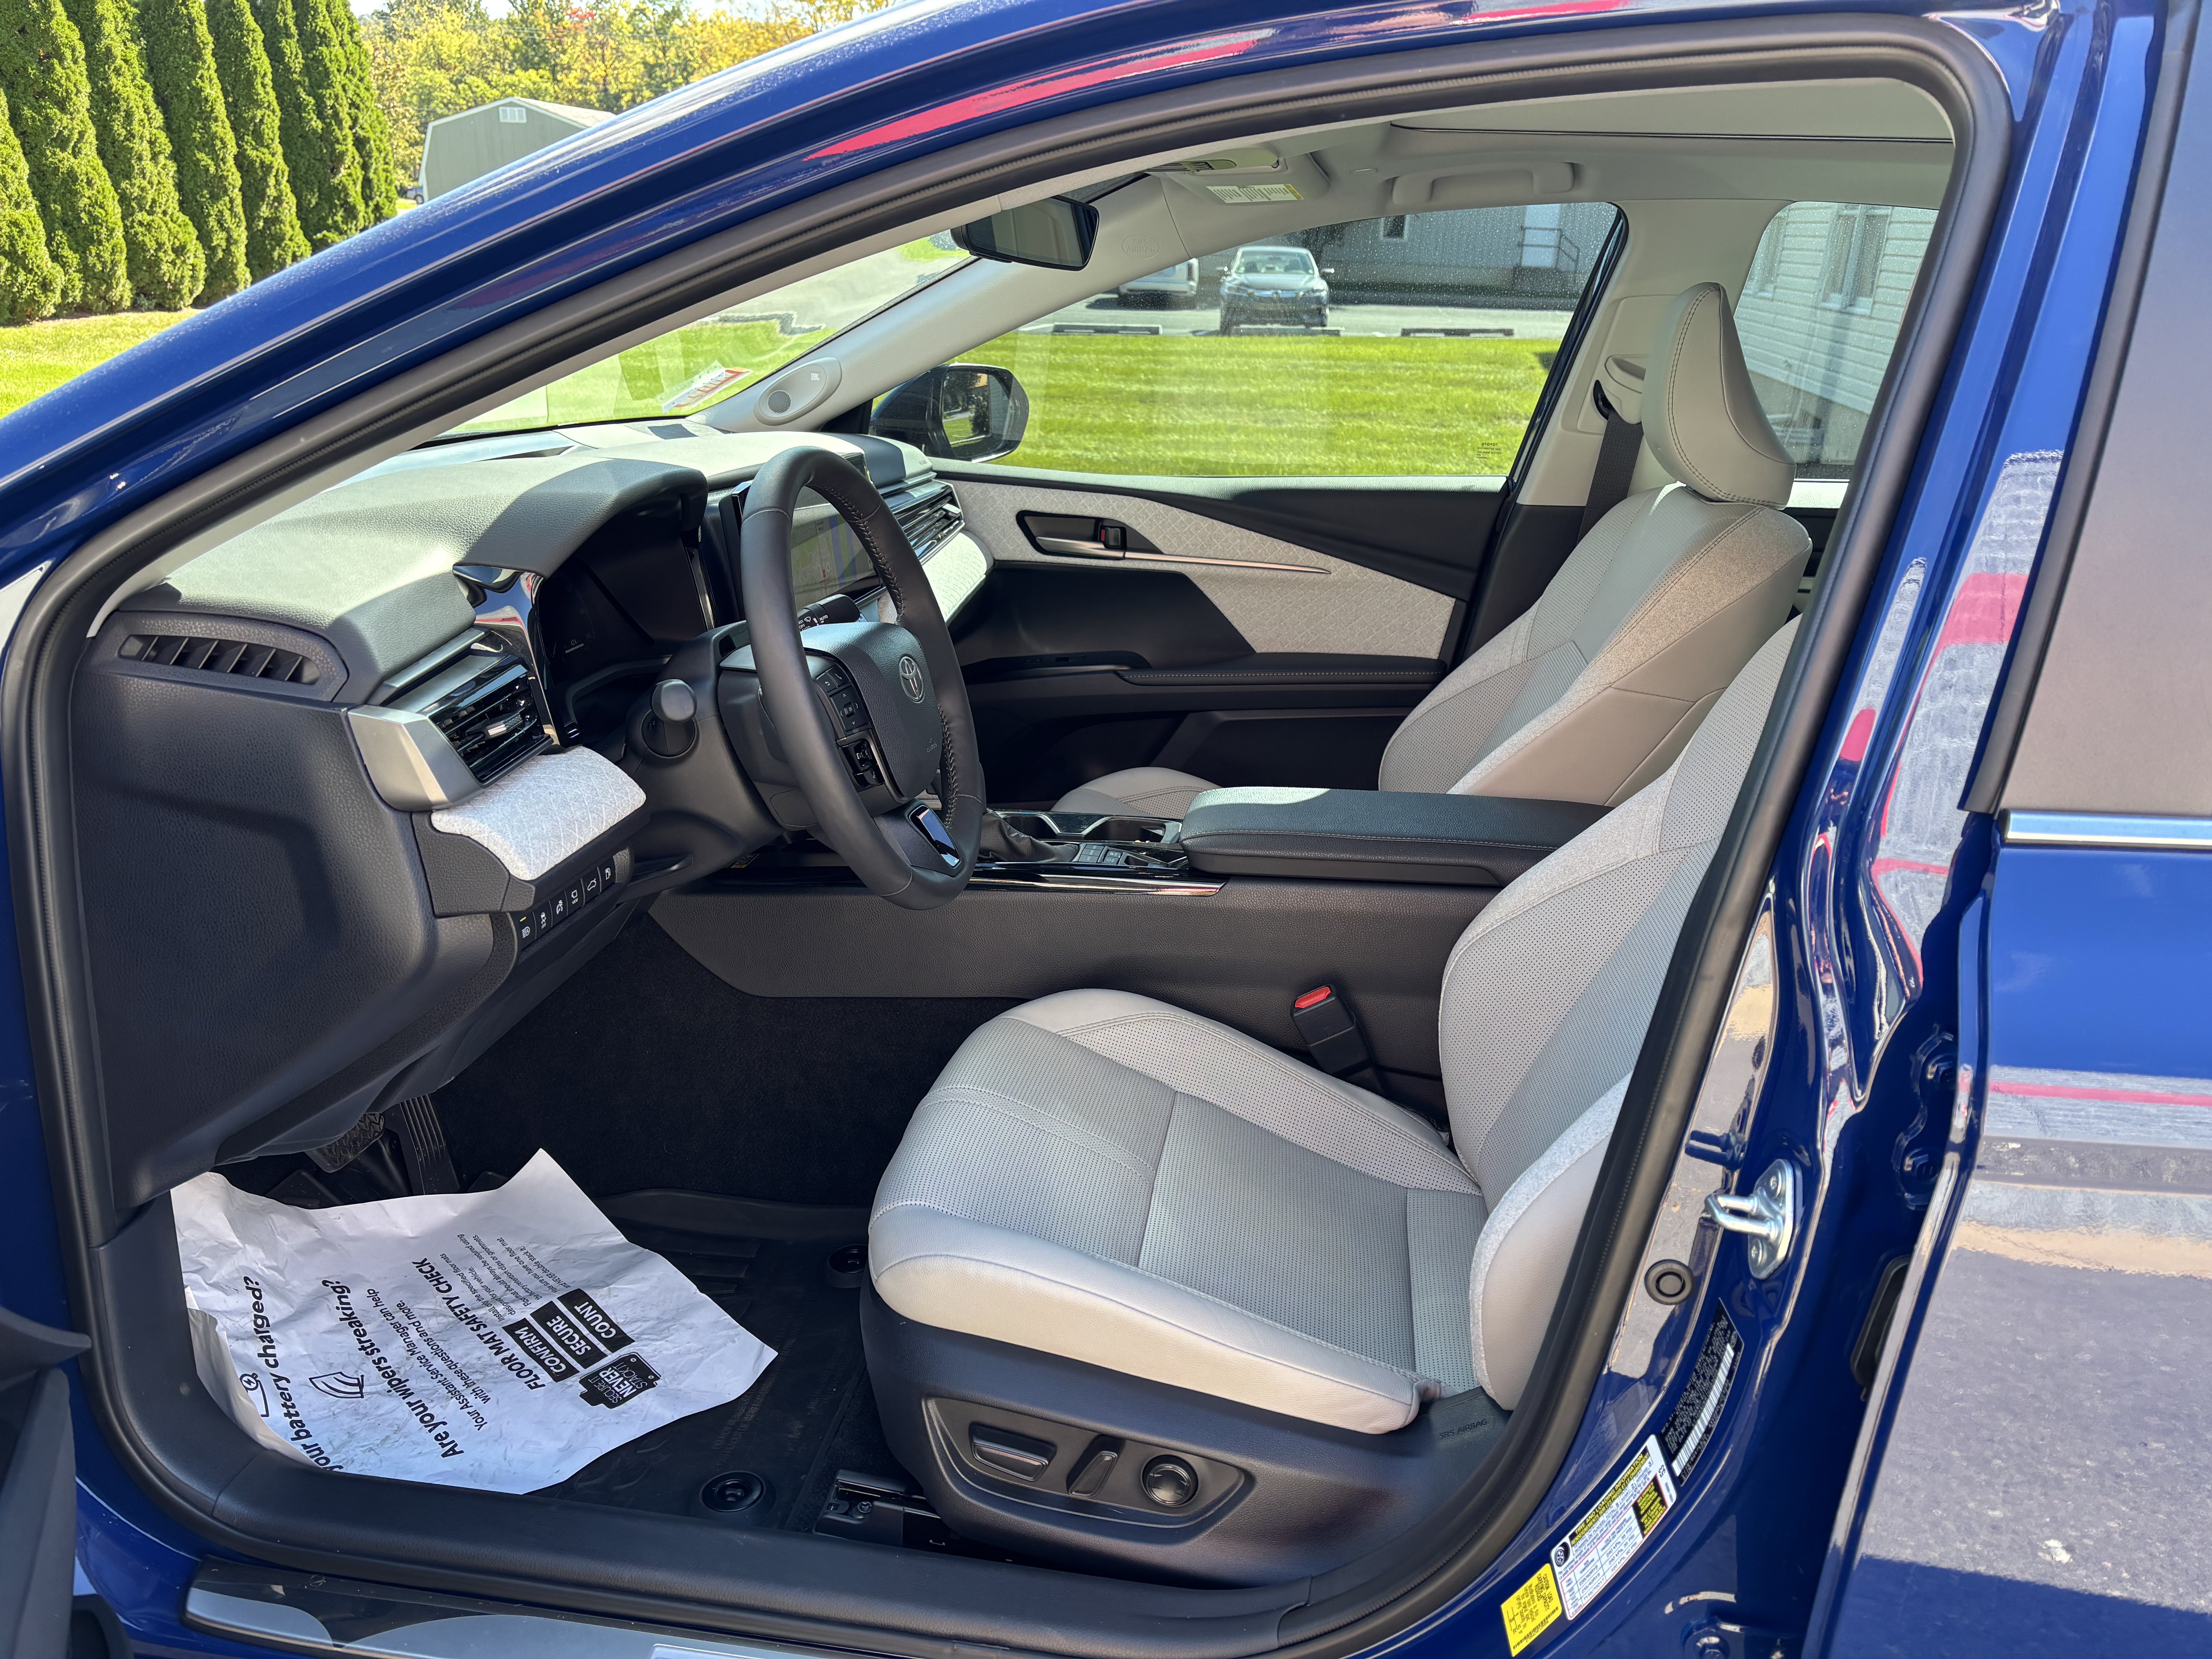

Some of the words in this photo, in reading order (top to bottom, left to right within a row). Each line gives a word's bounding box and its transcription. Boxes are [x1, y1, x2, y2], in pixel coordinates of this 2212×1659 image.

[811, 372, 820, 381] JBL
[457, 1233, 470, 1245] using
[472, 1234, 494, 1255] grommets.
[496, 1237, 508, 1247] mat
[440, 1253, 452, 1264] mats
[465, 1245, 484, 1260] secured
[504, 1246, 517, 1257] floor
[514, 1255, 524, 1265] one
[522, 1250, 536, 1262] stack
[411, 1257, 452, 1293] CHECK
[448, 1263, 461, 1273] floor
[486, 1266, 501, 1280] always
[495, 1260, 507, 1271] clips
[522, 1264, 534, 1274] have
[533, 1261, 550, 1273] double
[456, 1272, 478, 1294] specified
[468, 1266, 484, 1285] vehicle.
[503, 1270, 523, 1286] retention
[538, 1278, 550, 1286] sure
[546, 1272, 563, 1284] NEVER
[480, 1285, 495, 1294] your
[496, 1279, 514, 1292] should
[511, 1290, 522, 1298] mat
[366, 1288, 385, 1308] help
[474, 1294, 484, 1302] the
[495, 1297, 516, 1315] designed
[321, 1279, 381, 1356] streaking?
[379, 1307, 395, 1321] can
[396, 1300, 417, 1321] more.
[441, 1295, 488, 1332] SAFETY
[487, 1305, 505, 1322] Install
[574, 1301, 616, 1338] COUNT
[243, 1276, 279, 1369] charged?
[408, 1320, 428, 1338] and
[389, 1321, 421, 1356] Manager
[476, 1330, 510, 1356] MAT
[546, 1315, 591, 1355] SECURE
[423, 1337, 459, 1370] questions
[514, 1326, 566, 1373] CONFIRM
[416, 1354, 443, 1379] Service
[500, 1353, 546, 1390] FLOOR
[612, 1362, 627, 1370] IT
[371, 1356, 415, 1400] wipers
[453, 1367, 476, 1389] these
[587, 1375, 600, 1384] IT
[599, 1367, 637, 1398] NEVER
[618, 1367, 647, 1389] STACK
[436, 1377, 473, 1410] Assistant
[471, 1386, 491, 1404] with
[593, 1379, 622, 1403] SECURE
[269, 1372, 313, 1441] battery
[405, 1399, 448, 1434] your
[466, 1409, 488, 1431] Your
[1439, 1429, 1455, 1439] SRS
[1457, 1419, 1487, 1435] AIRBAG
[434, 1430, 465, 1458] Are
[301, 1443, 344, 1471] your
[1625, 1476, 1630, 1484] LE
[1657, 1463, 1666, 1478] 53
[1575, 1520, 1585, 1536] TIRE
[1585, 1510, 1595, 1525] AND
[1595, 1487, 1615, 1513] LOADING
[1614, 1453, 1644, 1491] INFORMATION
